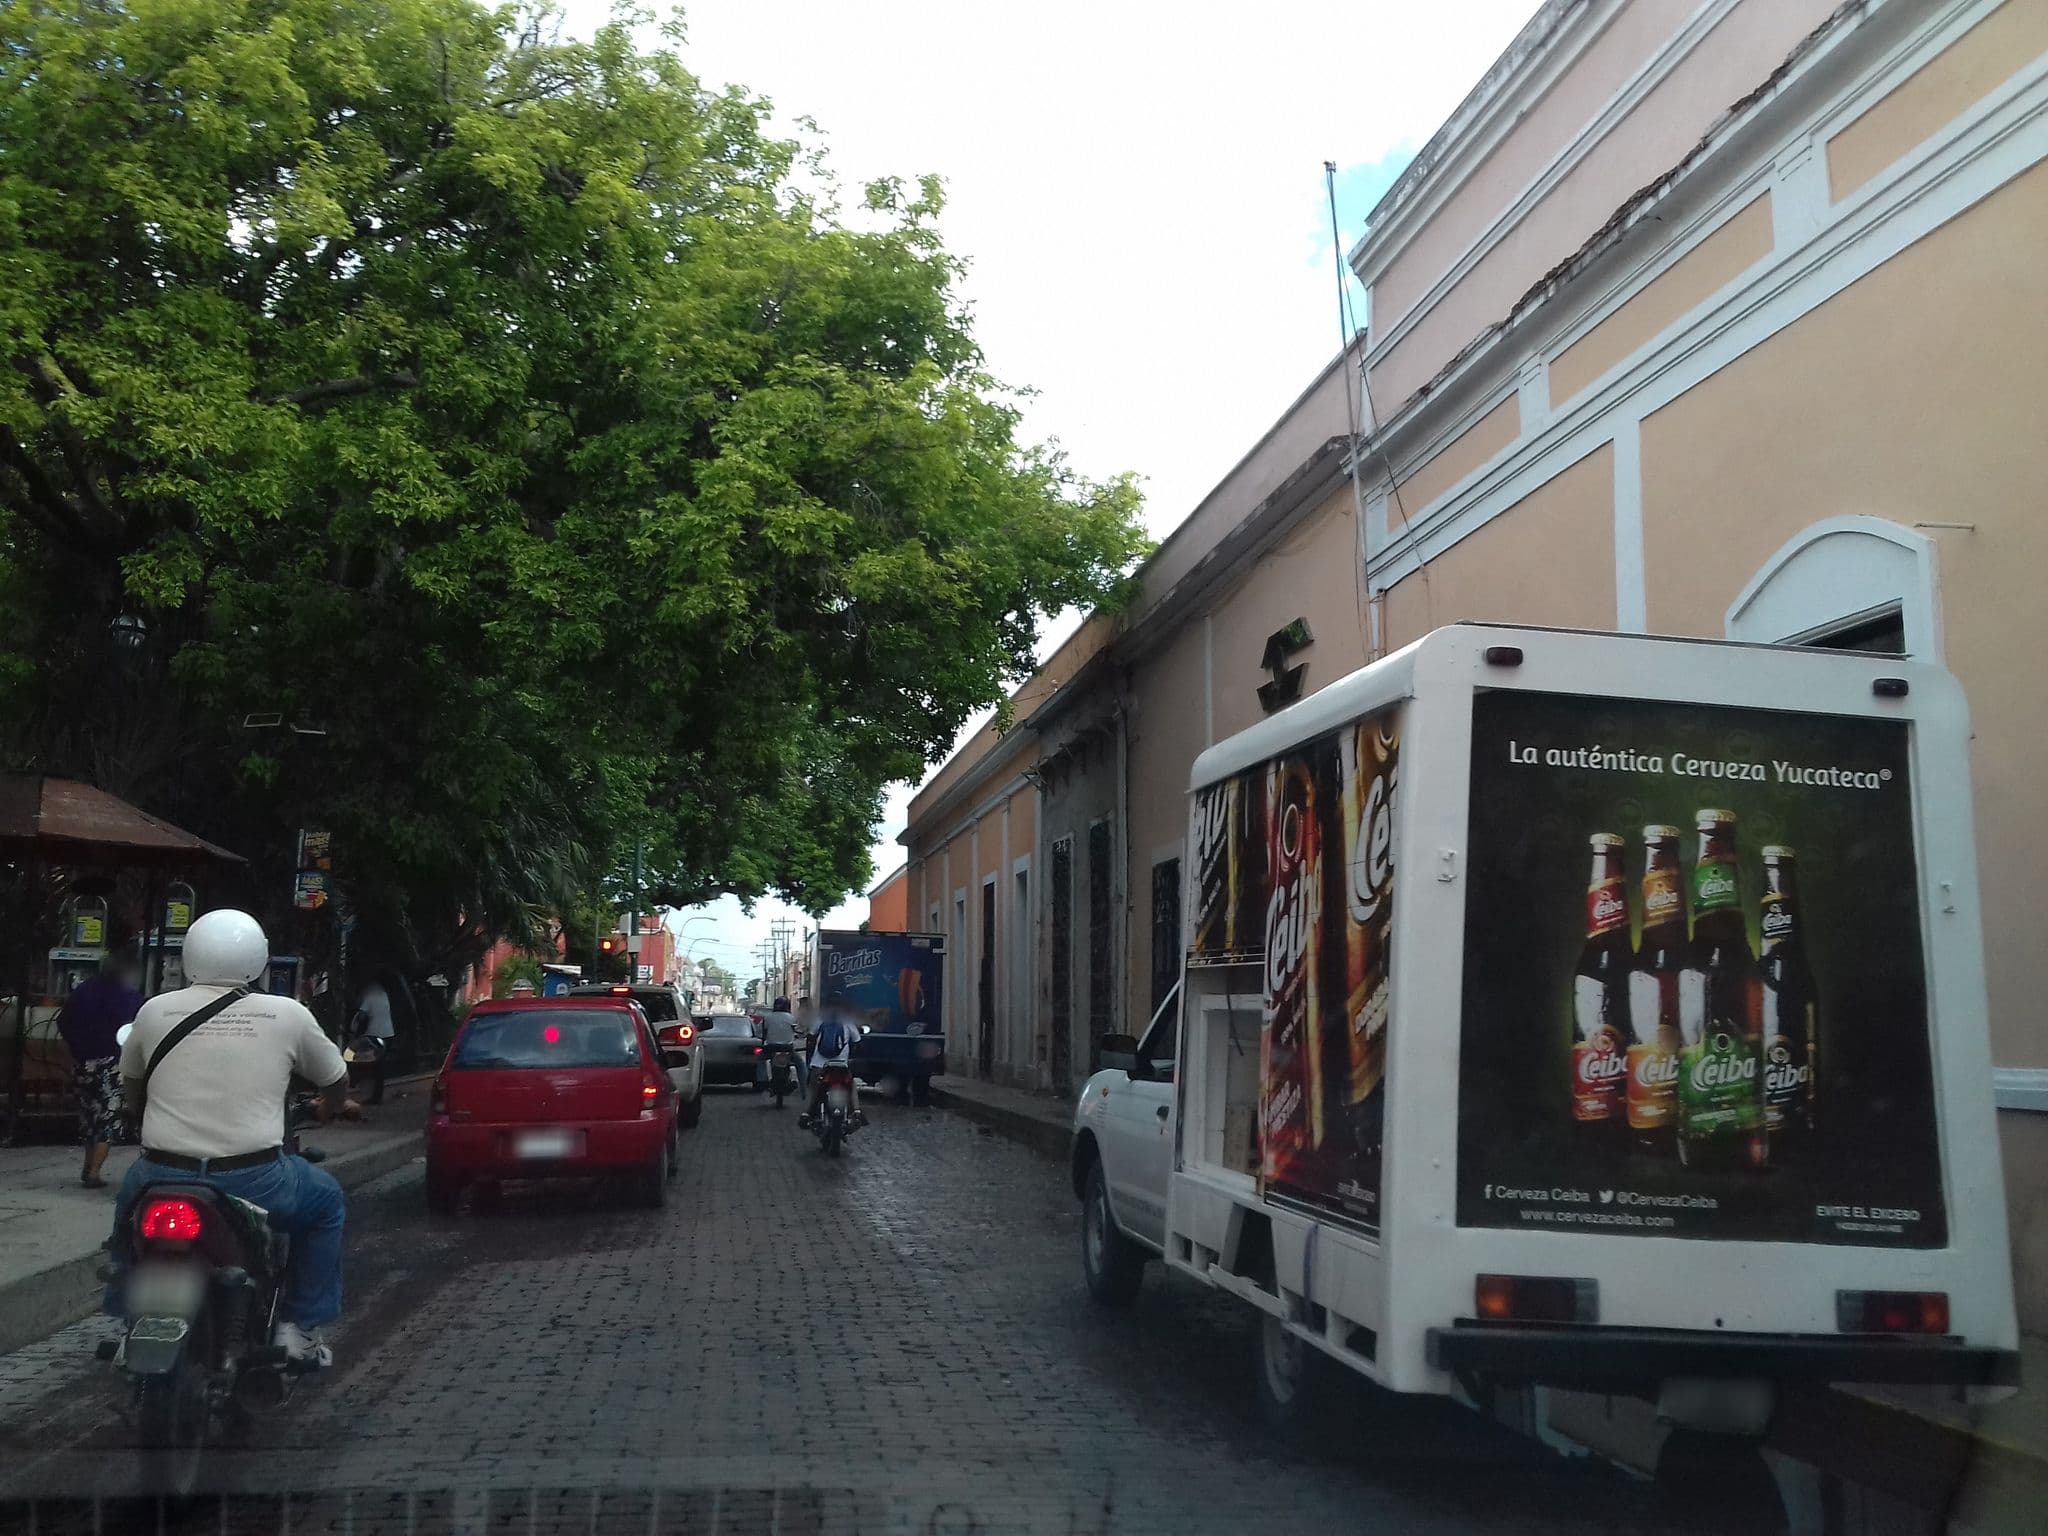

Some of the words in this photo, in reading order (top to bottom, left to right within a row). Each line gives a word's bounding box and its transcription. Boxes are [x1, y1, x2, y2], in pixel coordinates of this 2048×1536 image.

[1509, 740, 1538, 766] La
[1545, 743, 1663, 774] auténtica
[1671, 753, 1767, 782] Cerveza
[828, 949, 882, 976] Barritas
[1635, 1054, 1680, 1087] Cei
[1691, 1054, 1756, 1091] Ceiba
[1495, 1185, 1549, 1201] Cerveza
[1551, 1188, 1590, 1202] Ceiba
[1519, 1208, 1675, 1227] www.cervezaceiba.com
[1852, 1206, 1869, 1218] EL
